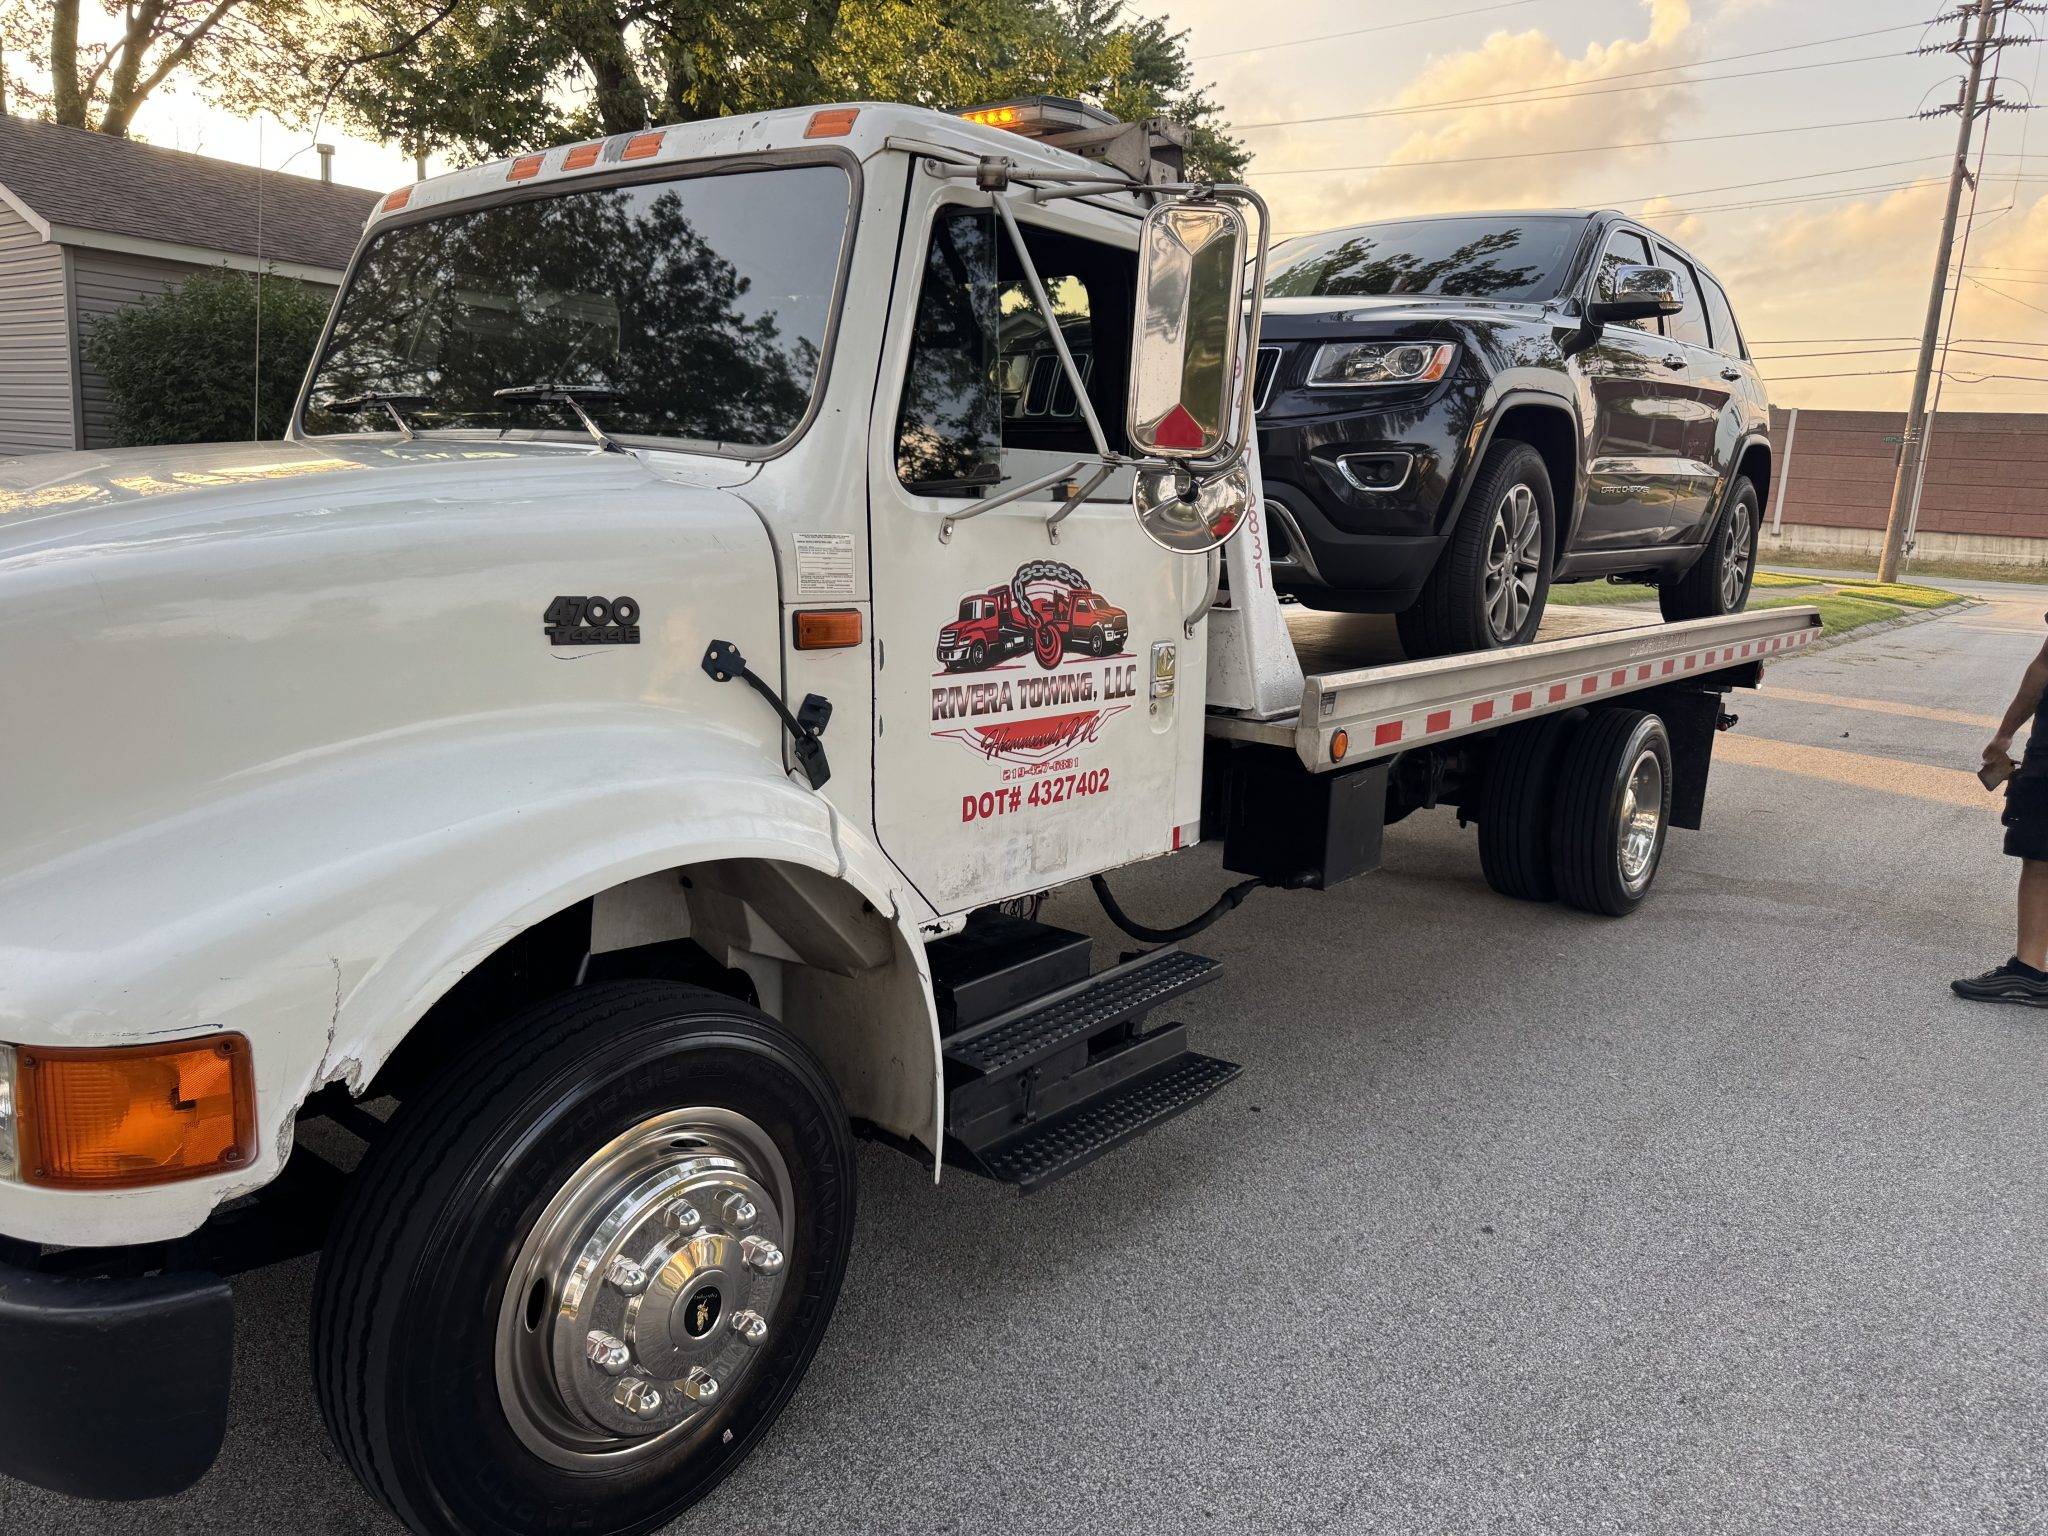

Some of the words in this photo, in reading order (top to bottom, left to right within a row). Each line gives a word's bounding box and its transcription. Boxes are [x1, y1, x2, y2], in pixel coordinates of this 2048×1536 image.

[544, 596, 640, 626] 4700
[931, 680, 1013, 721] RIVERA
[1018, 671, 1098, 709] TOWING,
[1104, 664, 1137, 700] LLC
[1002, 757, 1079, 781] 219-427-6831
[962, 786, 1021, 823] DOT#
[1027, 767, 1109, 808] 4327402
